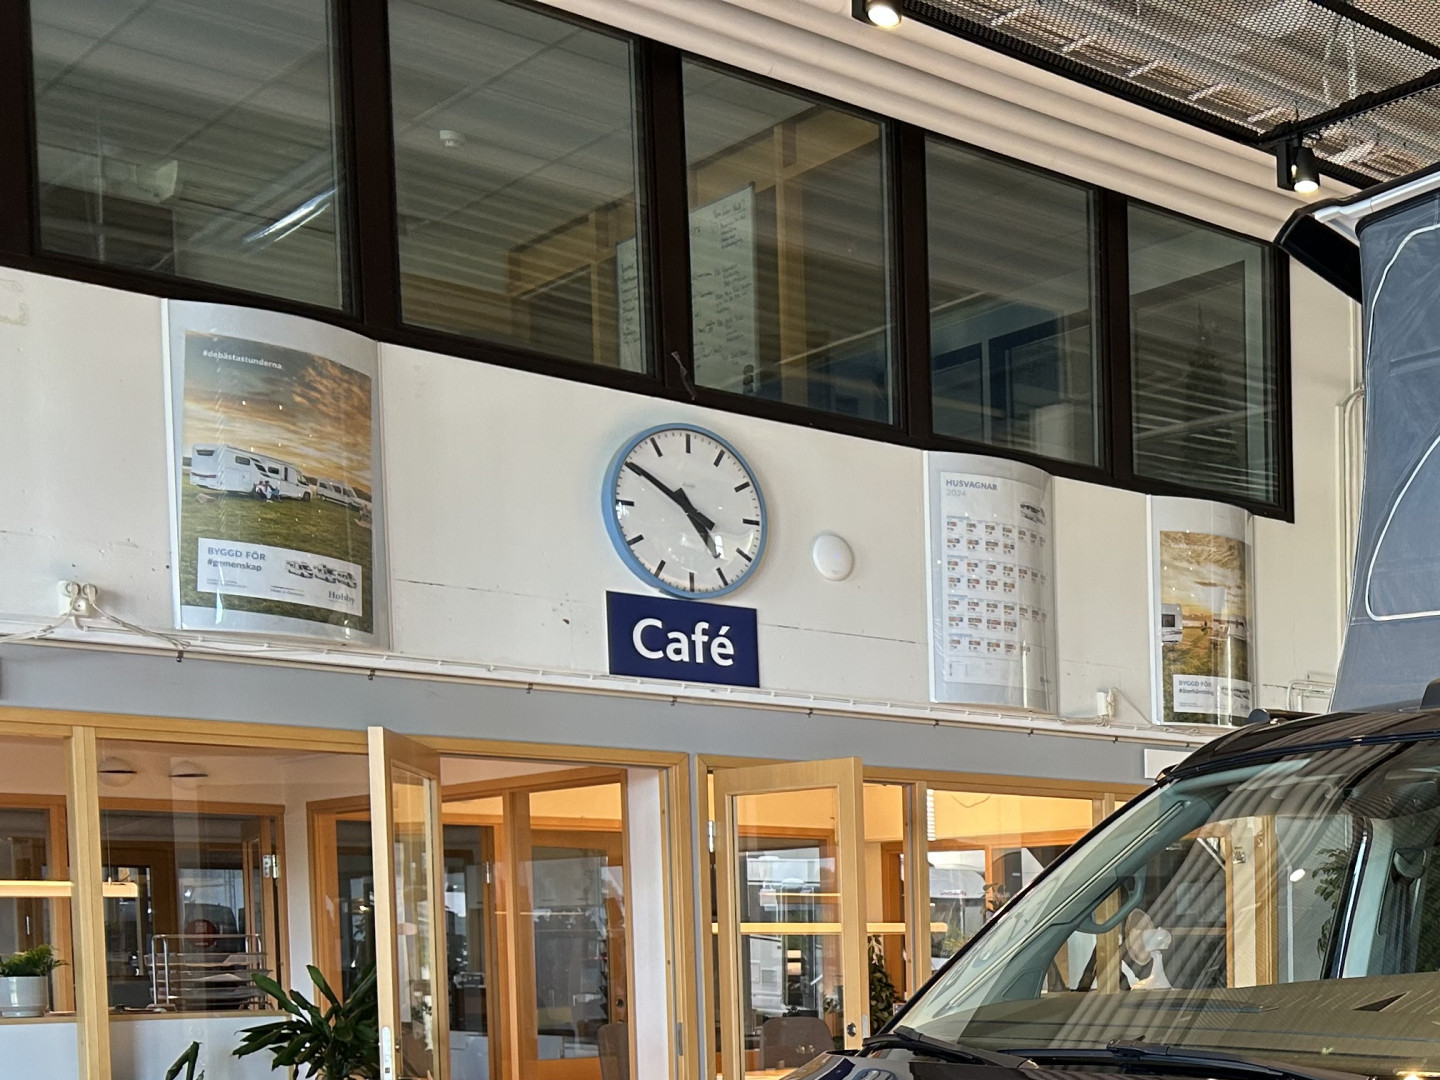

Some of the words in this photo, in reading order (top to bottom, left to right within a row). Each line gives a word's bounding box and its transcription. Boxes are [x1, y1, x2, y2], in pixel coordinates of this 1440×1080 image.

[946, 480, 997, 490] HUSVAGNAR
[207, 547, 243, 558] BYGGD
[246, 549, 266, 561] FÖR
[632, 618, 735, 666] Café
